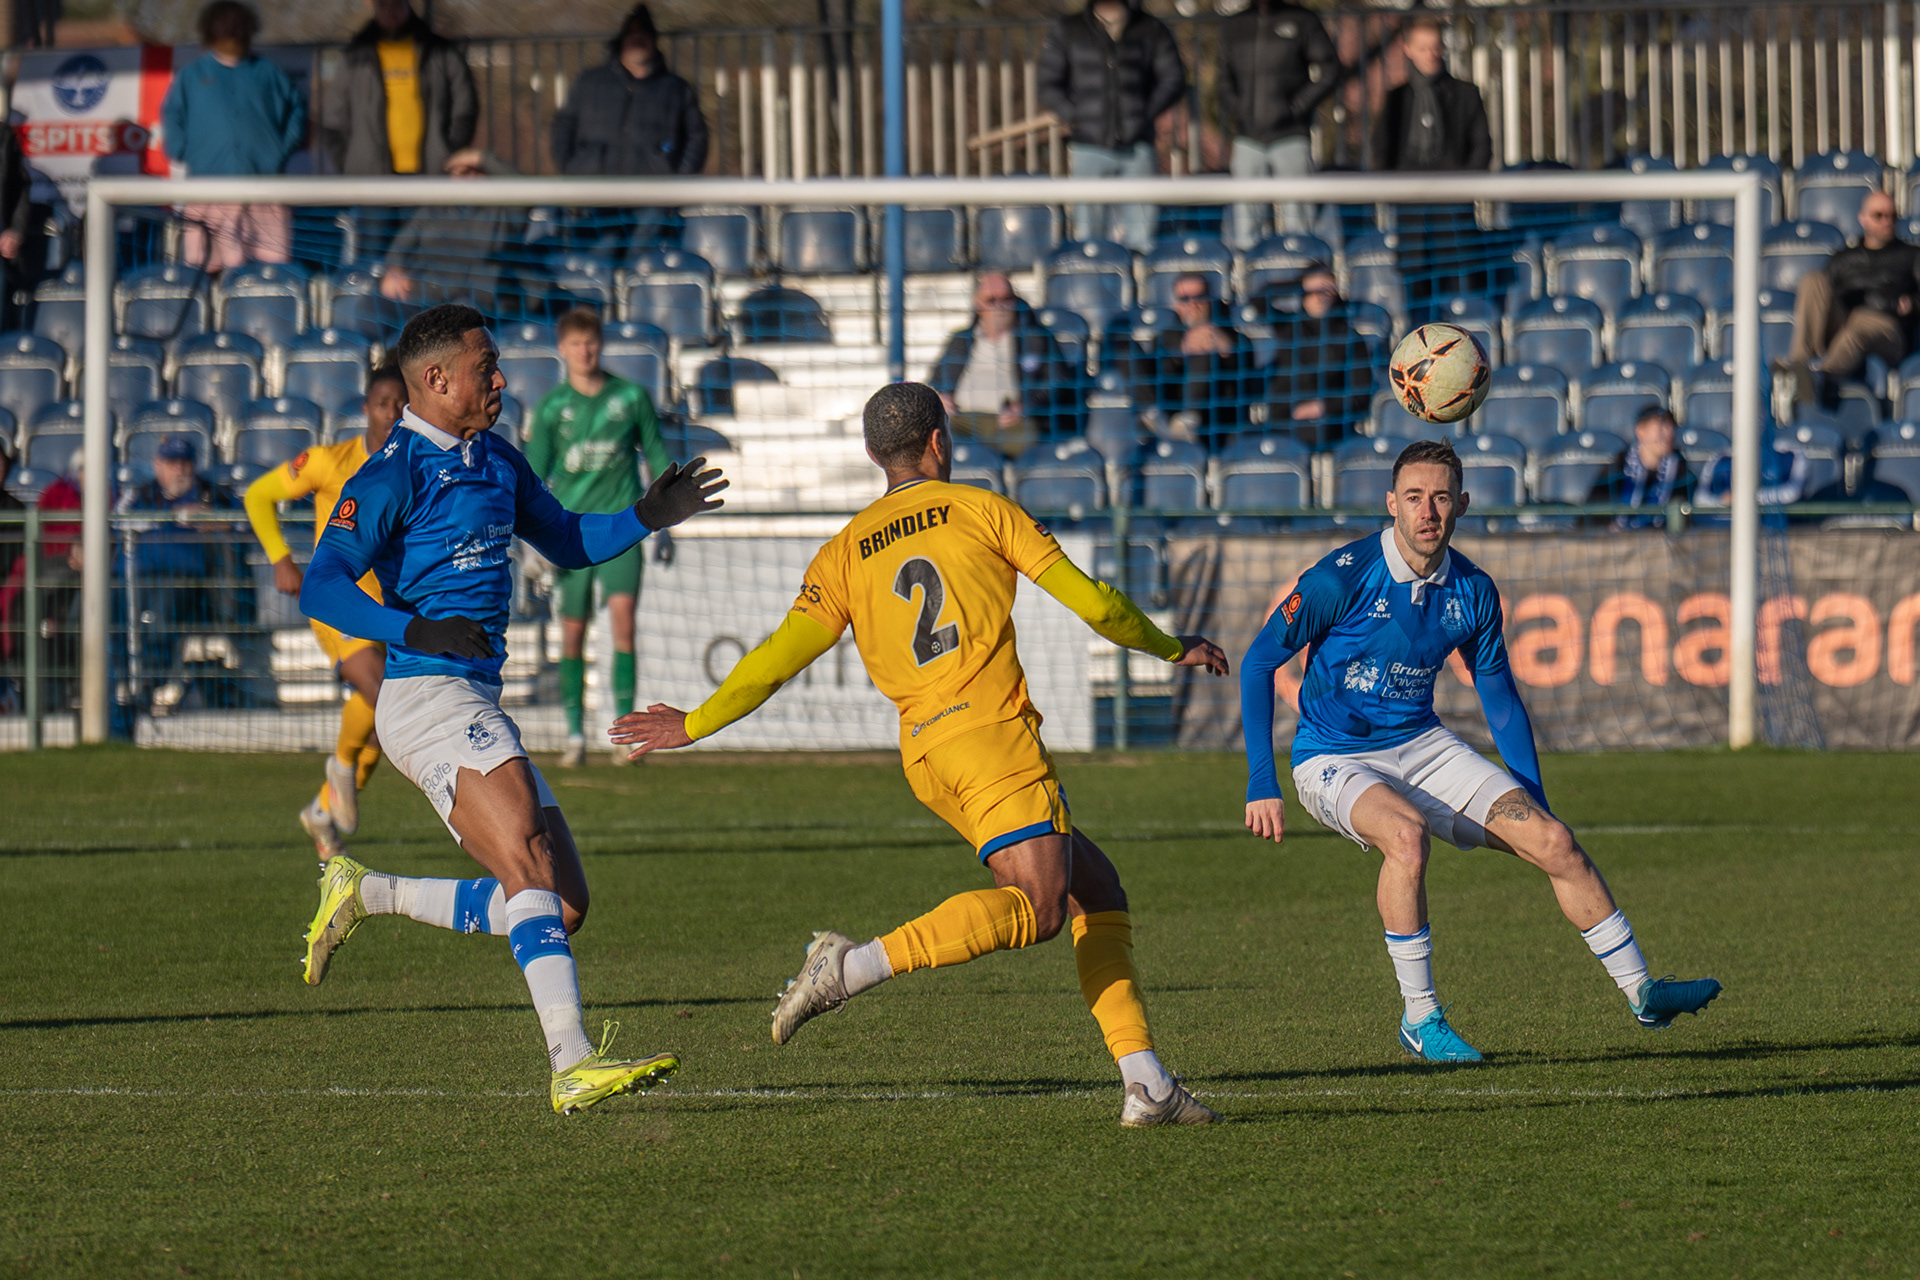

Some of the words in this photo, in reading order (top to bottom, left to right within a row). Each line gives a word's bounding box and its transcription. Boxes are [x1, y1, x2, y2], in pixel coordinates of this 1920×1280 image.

[28, 126, 112, 154] SPITS
[858, 504, 951, 560] BRINDLEY
[892, 555, 960, 667] 2
[1446, 591, 1920, 689] anara
[422, 762, 452, 790] Rolfe
